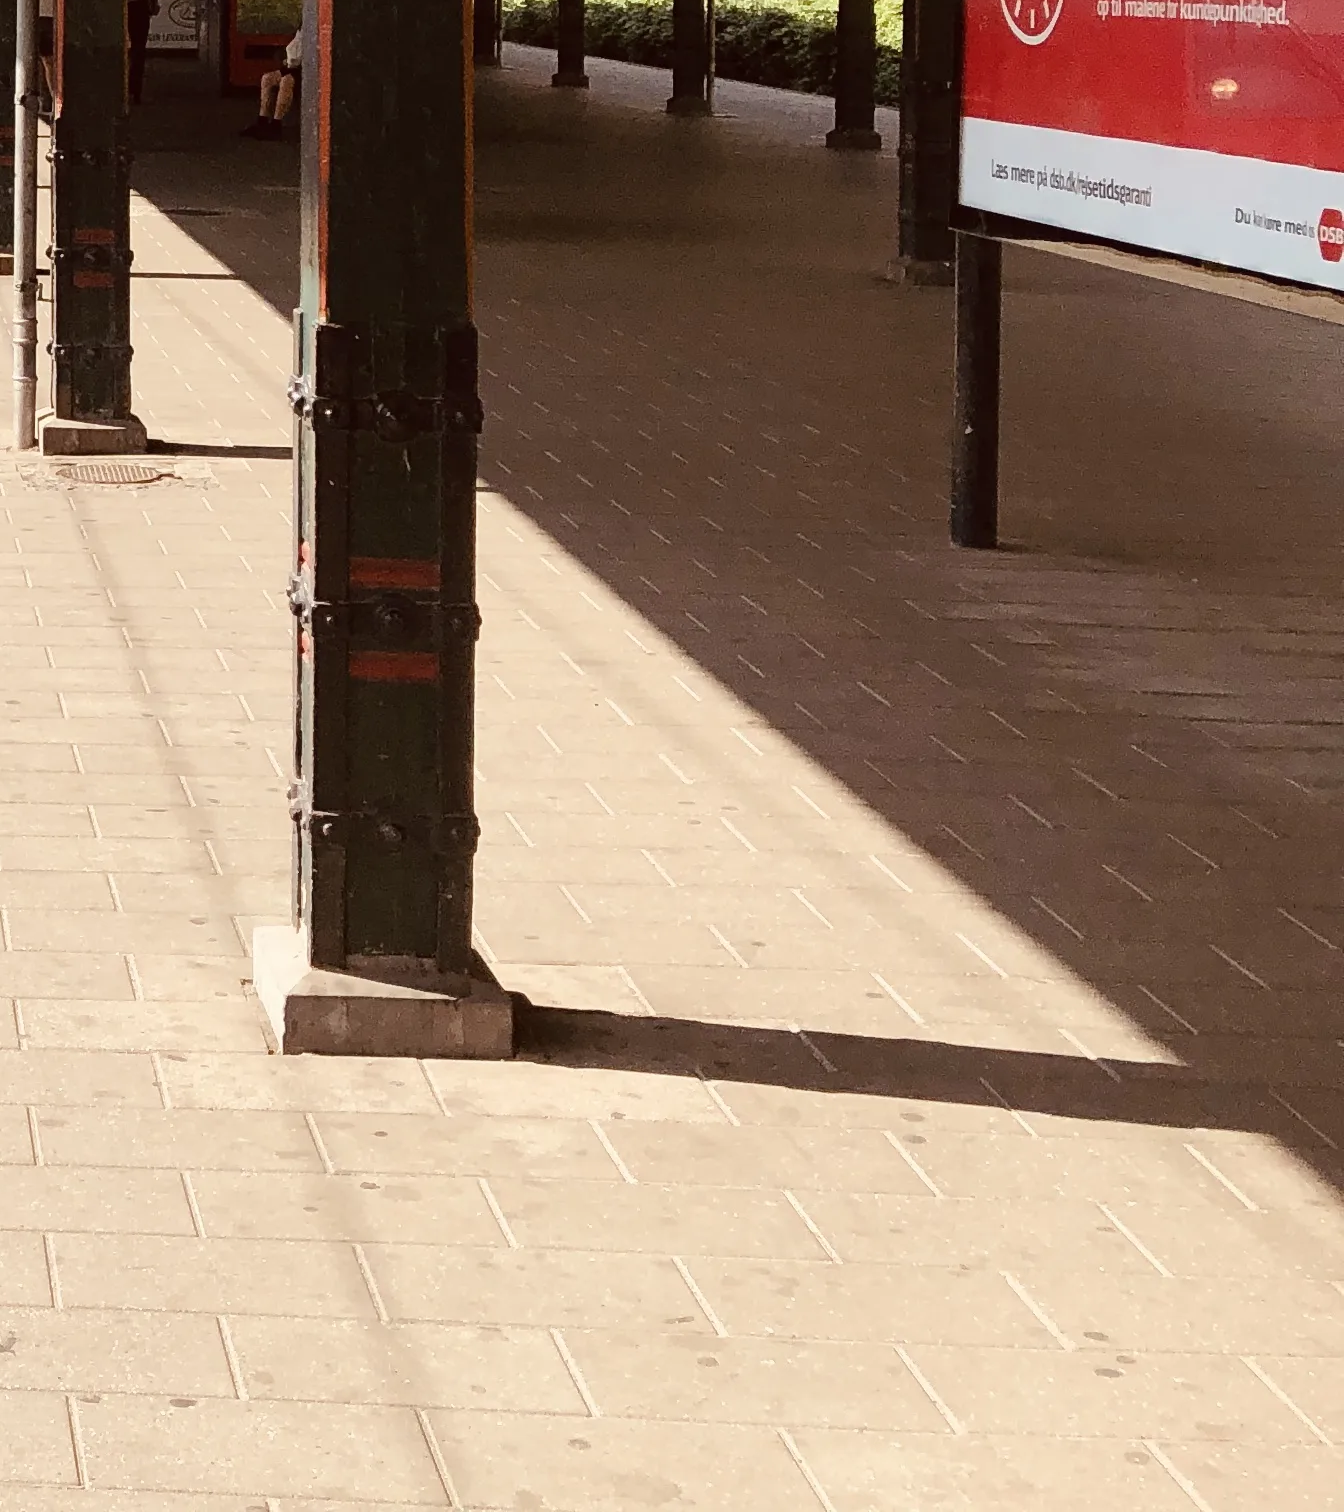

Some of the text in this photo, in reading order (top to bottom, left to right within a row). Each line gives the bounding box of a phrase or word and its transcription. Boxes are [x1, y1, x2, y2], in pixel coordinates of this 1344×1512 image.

[991, 159, 1008, 180] Læs
[1011, 166, 1035, 184] mere
[1036, 165, 1048, 191] på
[1235, 208, 1251, 225] Du
[1284, 220, 1307, 236] med
[1320, 225, 1344, 245] DSB
